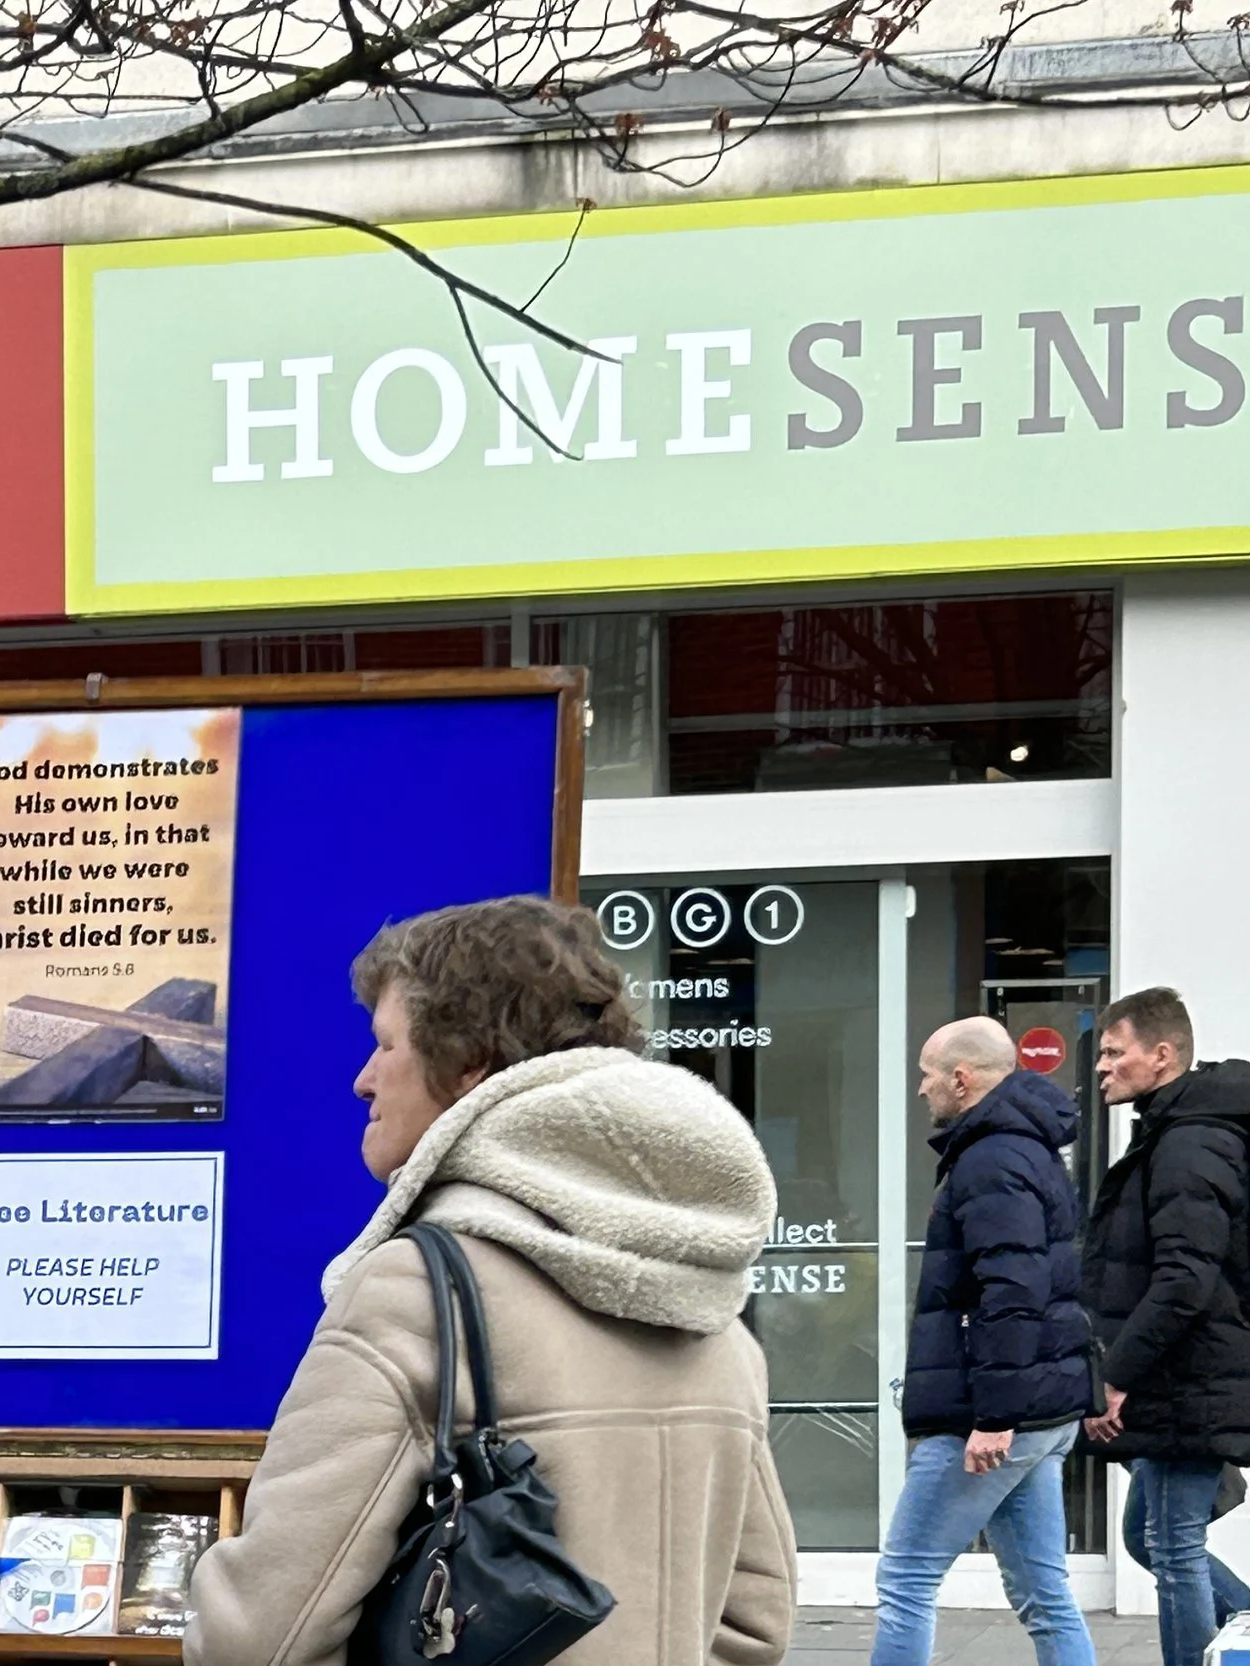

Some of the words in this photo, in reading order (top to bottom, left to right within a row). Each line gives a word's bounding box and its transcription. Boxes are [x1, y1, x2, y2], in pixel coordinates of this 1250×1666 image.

[33, 757, 220, 780] demonstrates
[14, 791, 56, 815] His
[61, 796, 118, 812] own
[124, 791, 180, 812] love
[81, 829, 118, 849] us,
[124, 823, 149, 846] in
[154, 822, 211, 845] that
[0, 859, 71, 882] while
[78, 862, 117, 881] we
[123, 860, 190, 880] were
[12, 892, 63, 915] still
[69, 892, 174, 916] sinners,
[59, 924, 122, 948] died
[129, 922, 172, 947] for
[177, 926, 217, 946] us.
[44, 963, 109, 979] Romans
[624, 972, 730, 999] omens
[41, 1199, 210, 1224] Literature
[5, 1257, 94, 1278] PLEASE
[99, 1257, 160, 1277] HELP
[22, 1286, 144, 1307] YOURSELF
